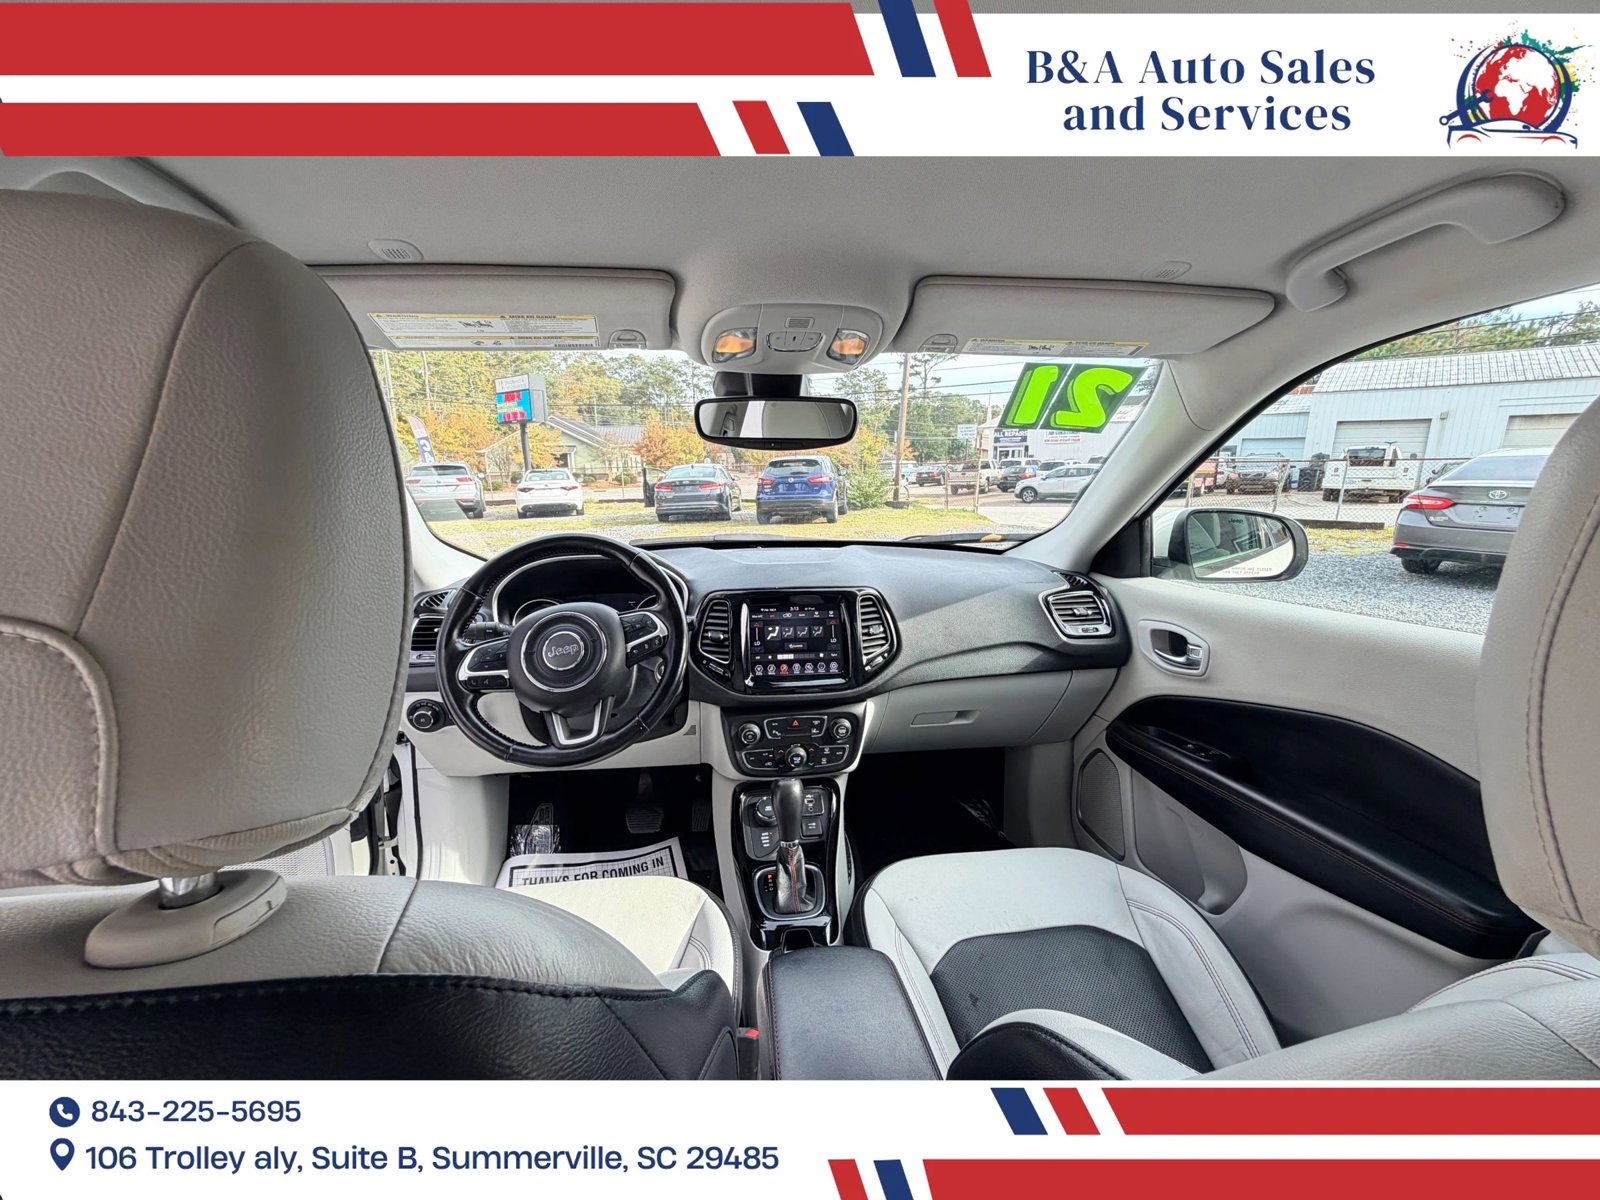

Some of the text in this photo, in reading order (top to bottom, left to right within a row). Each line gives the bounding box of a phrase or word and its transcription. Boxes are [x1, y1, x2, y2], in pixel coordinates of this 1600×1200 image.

[548, 644, 579, 657] Jeep
[522, 856, 664, 886] THANKS FOR COMING IN
